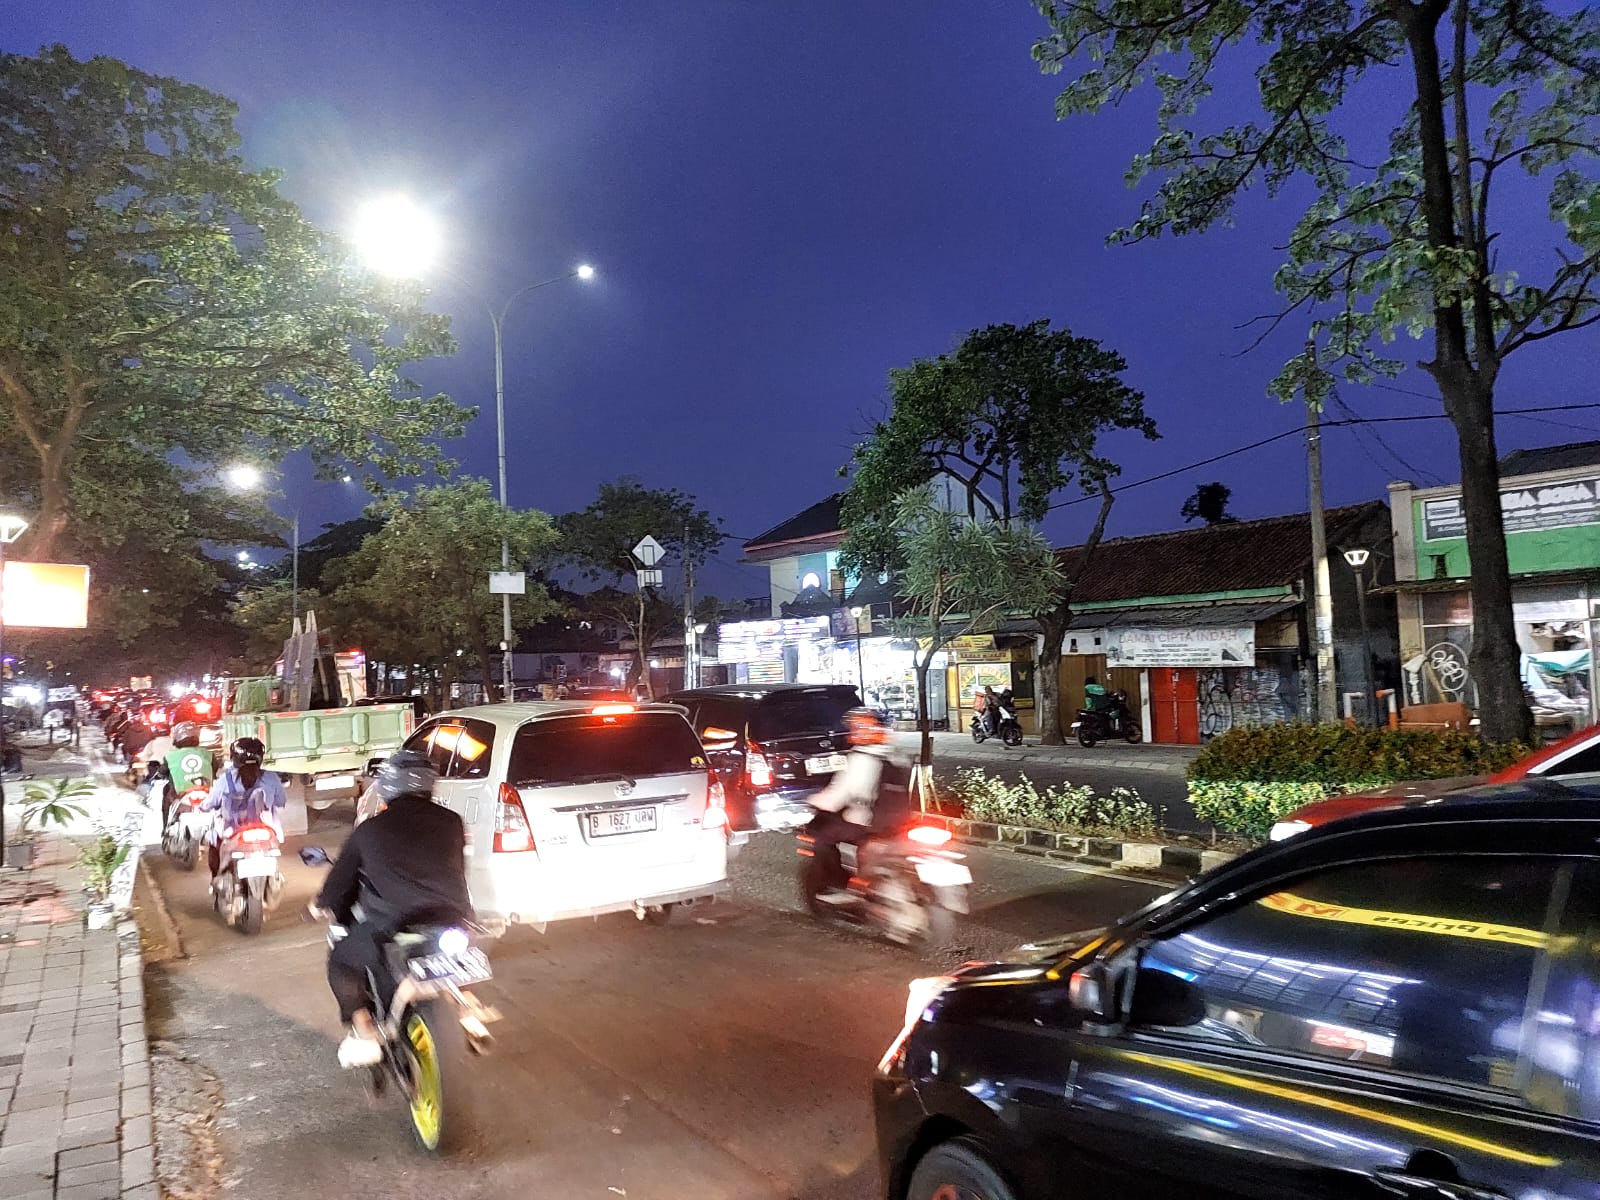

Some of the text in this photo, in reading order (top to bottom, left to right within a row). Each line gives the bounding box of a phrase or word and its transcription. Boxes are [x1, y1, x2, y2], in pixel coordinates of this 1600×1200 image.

[1158, 631, 1193, 643] CIPTA
[1196, 630, 1237, 642] INDAH
[592, 816, 599, 828] B
[608, 813, 630, 826] 1627
